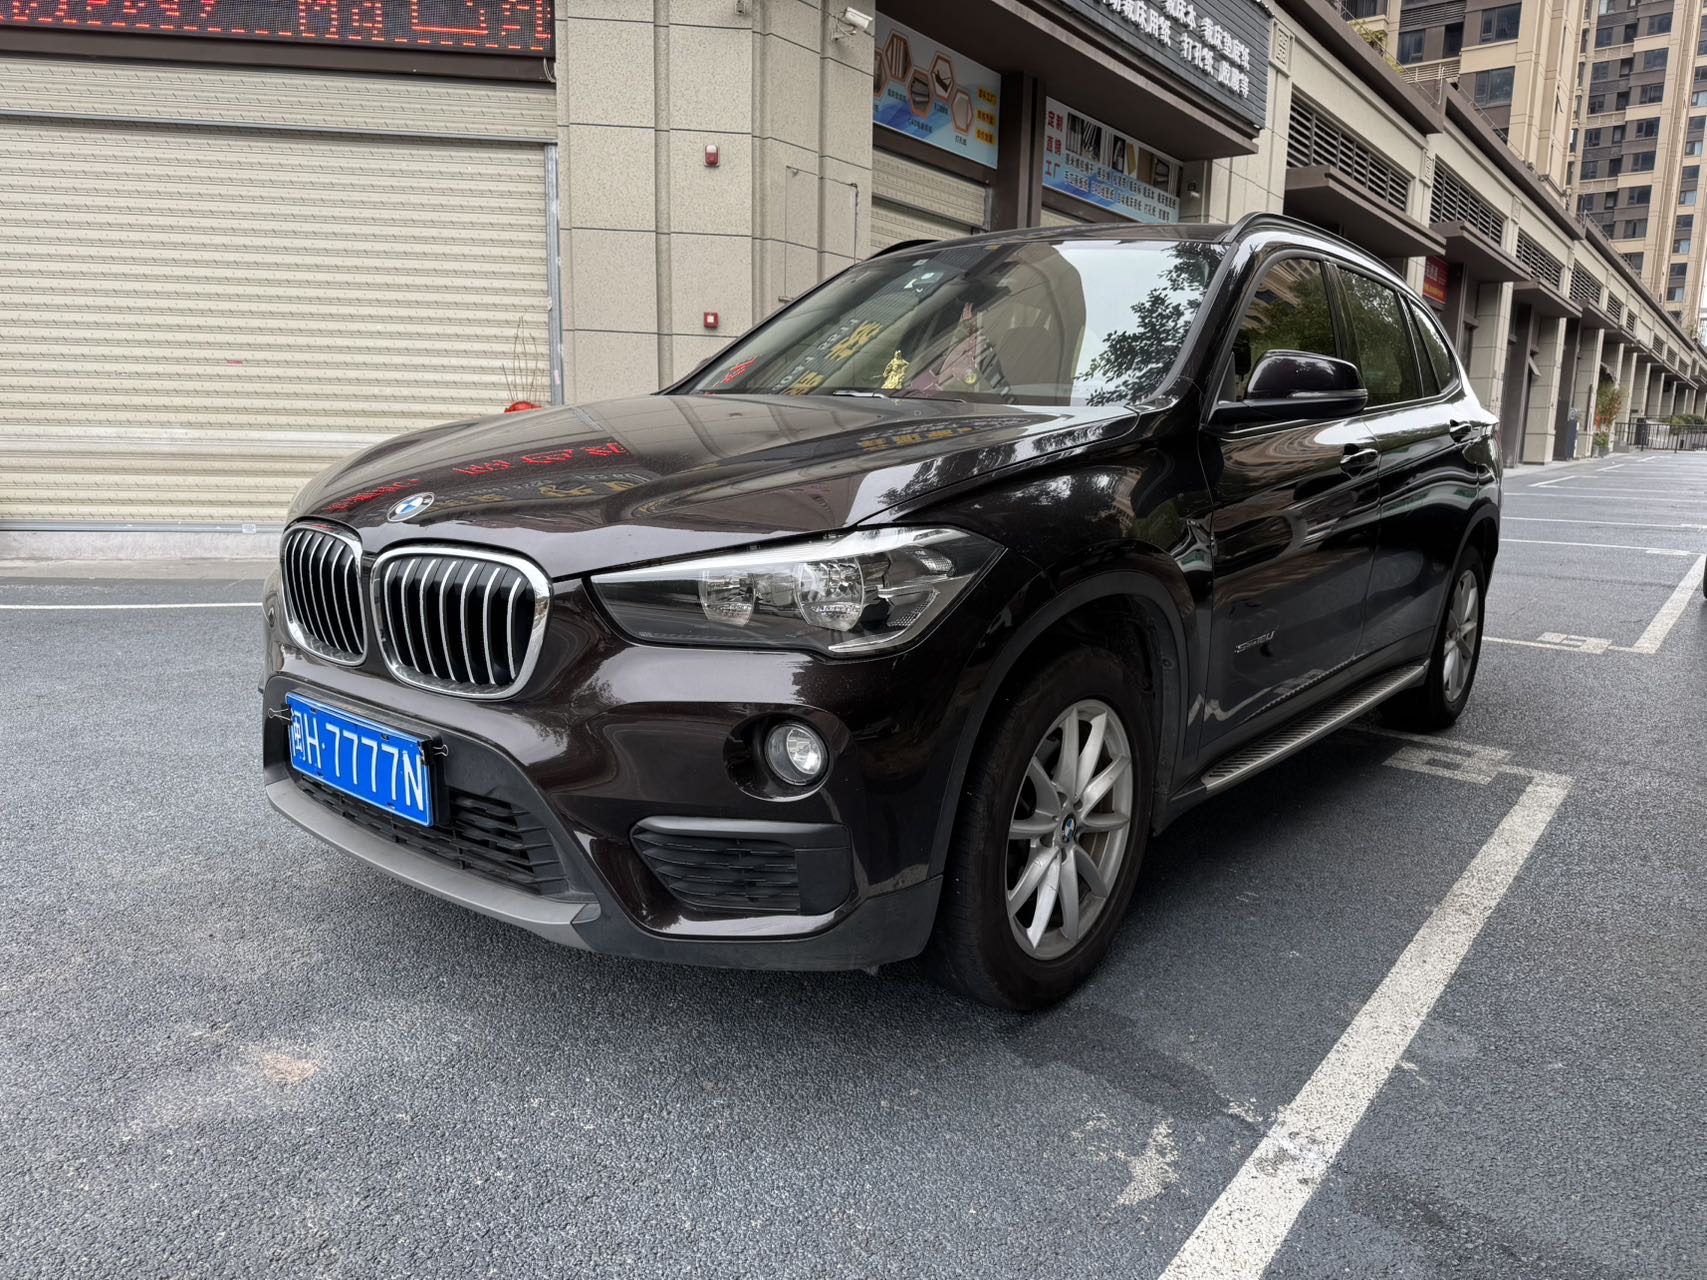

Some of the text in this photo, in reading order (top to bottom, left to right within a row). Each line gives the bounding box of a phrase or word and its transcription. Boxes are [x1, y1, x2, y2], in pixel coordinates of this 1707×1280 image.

[1180, 33, 1213, 75] 打孔纸
[1047, 110, 1064, 132] 定制
[1045, 159, 1060, 178] 工厂
